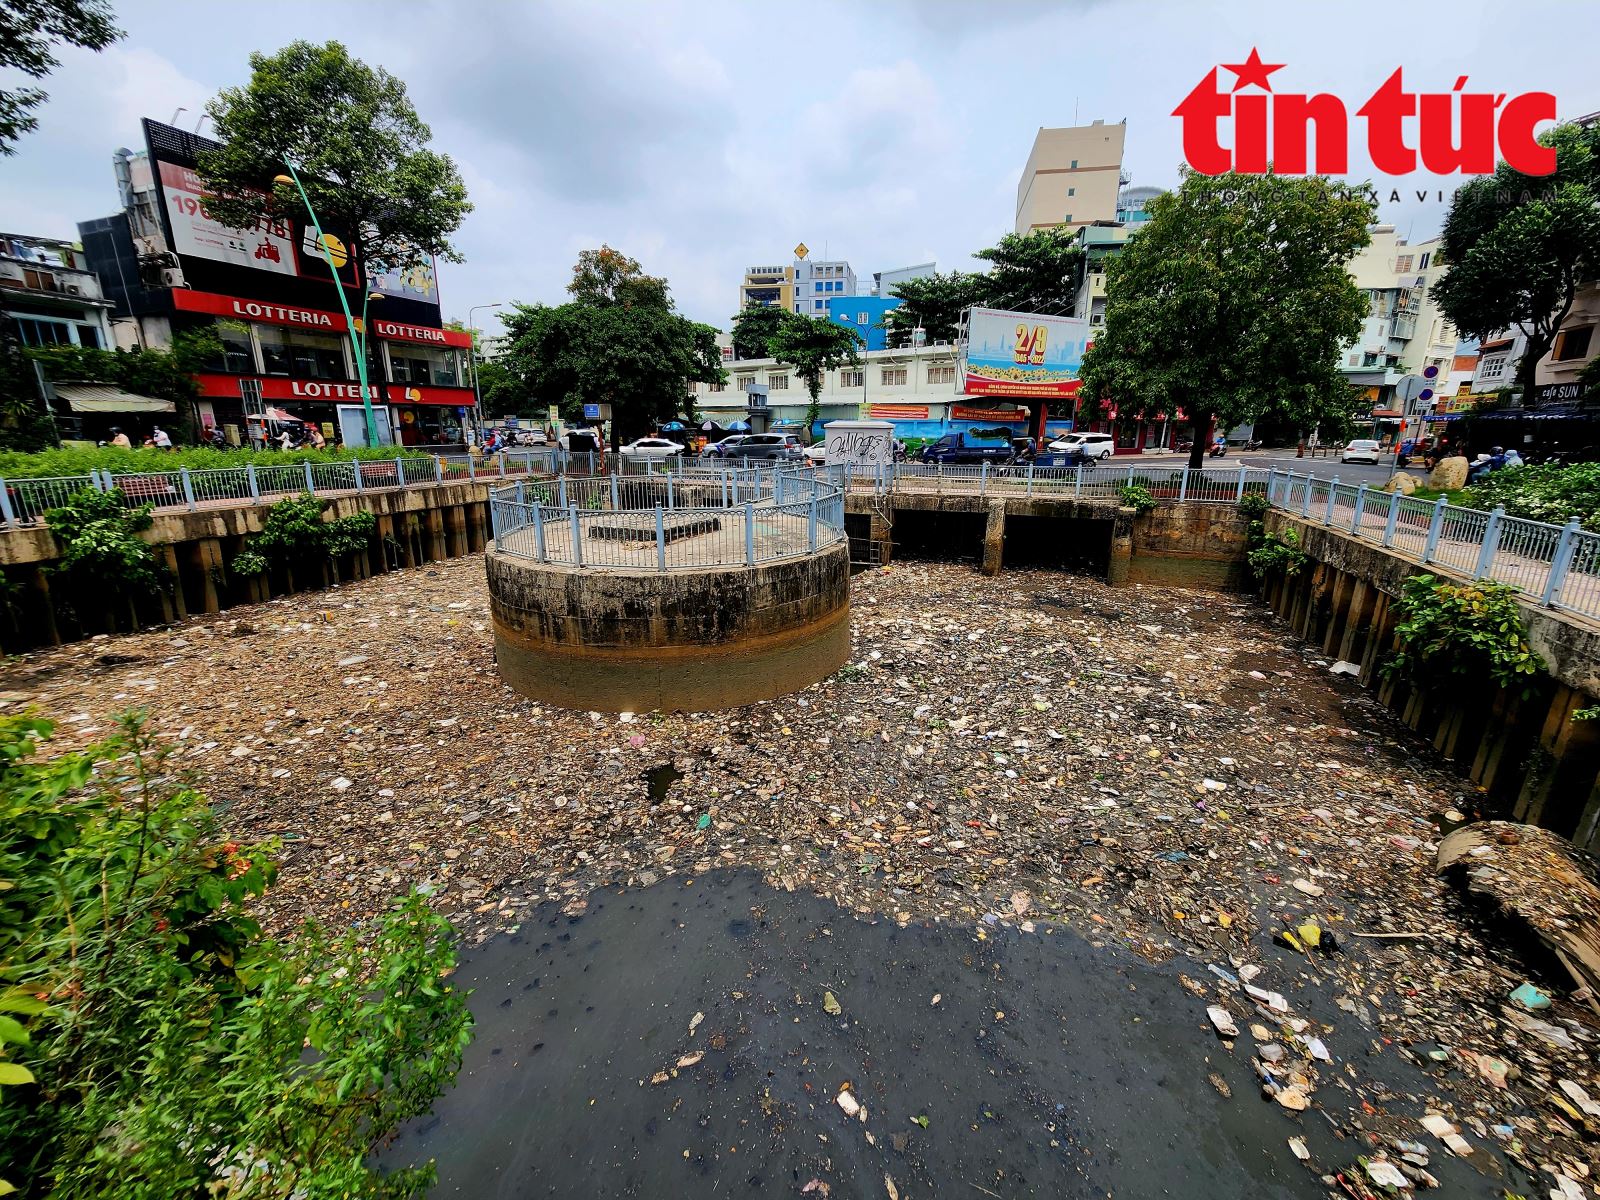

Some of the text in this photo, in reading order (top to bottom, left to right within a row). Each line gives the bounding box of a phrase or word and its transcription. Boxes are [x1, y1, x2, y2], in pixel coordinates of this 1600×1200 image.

[233, 300, 332, 326] LOTTERIA
[378, 323, 446, 342] LOTTERIA
[1014, 323, 1049, 356] 2/9
[291, 381, 392, 399] LOTTERI
[1557, 384, 1579, 399] SUN
